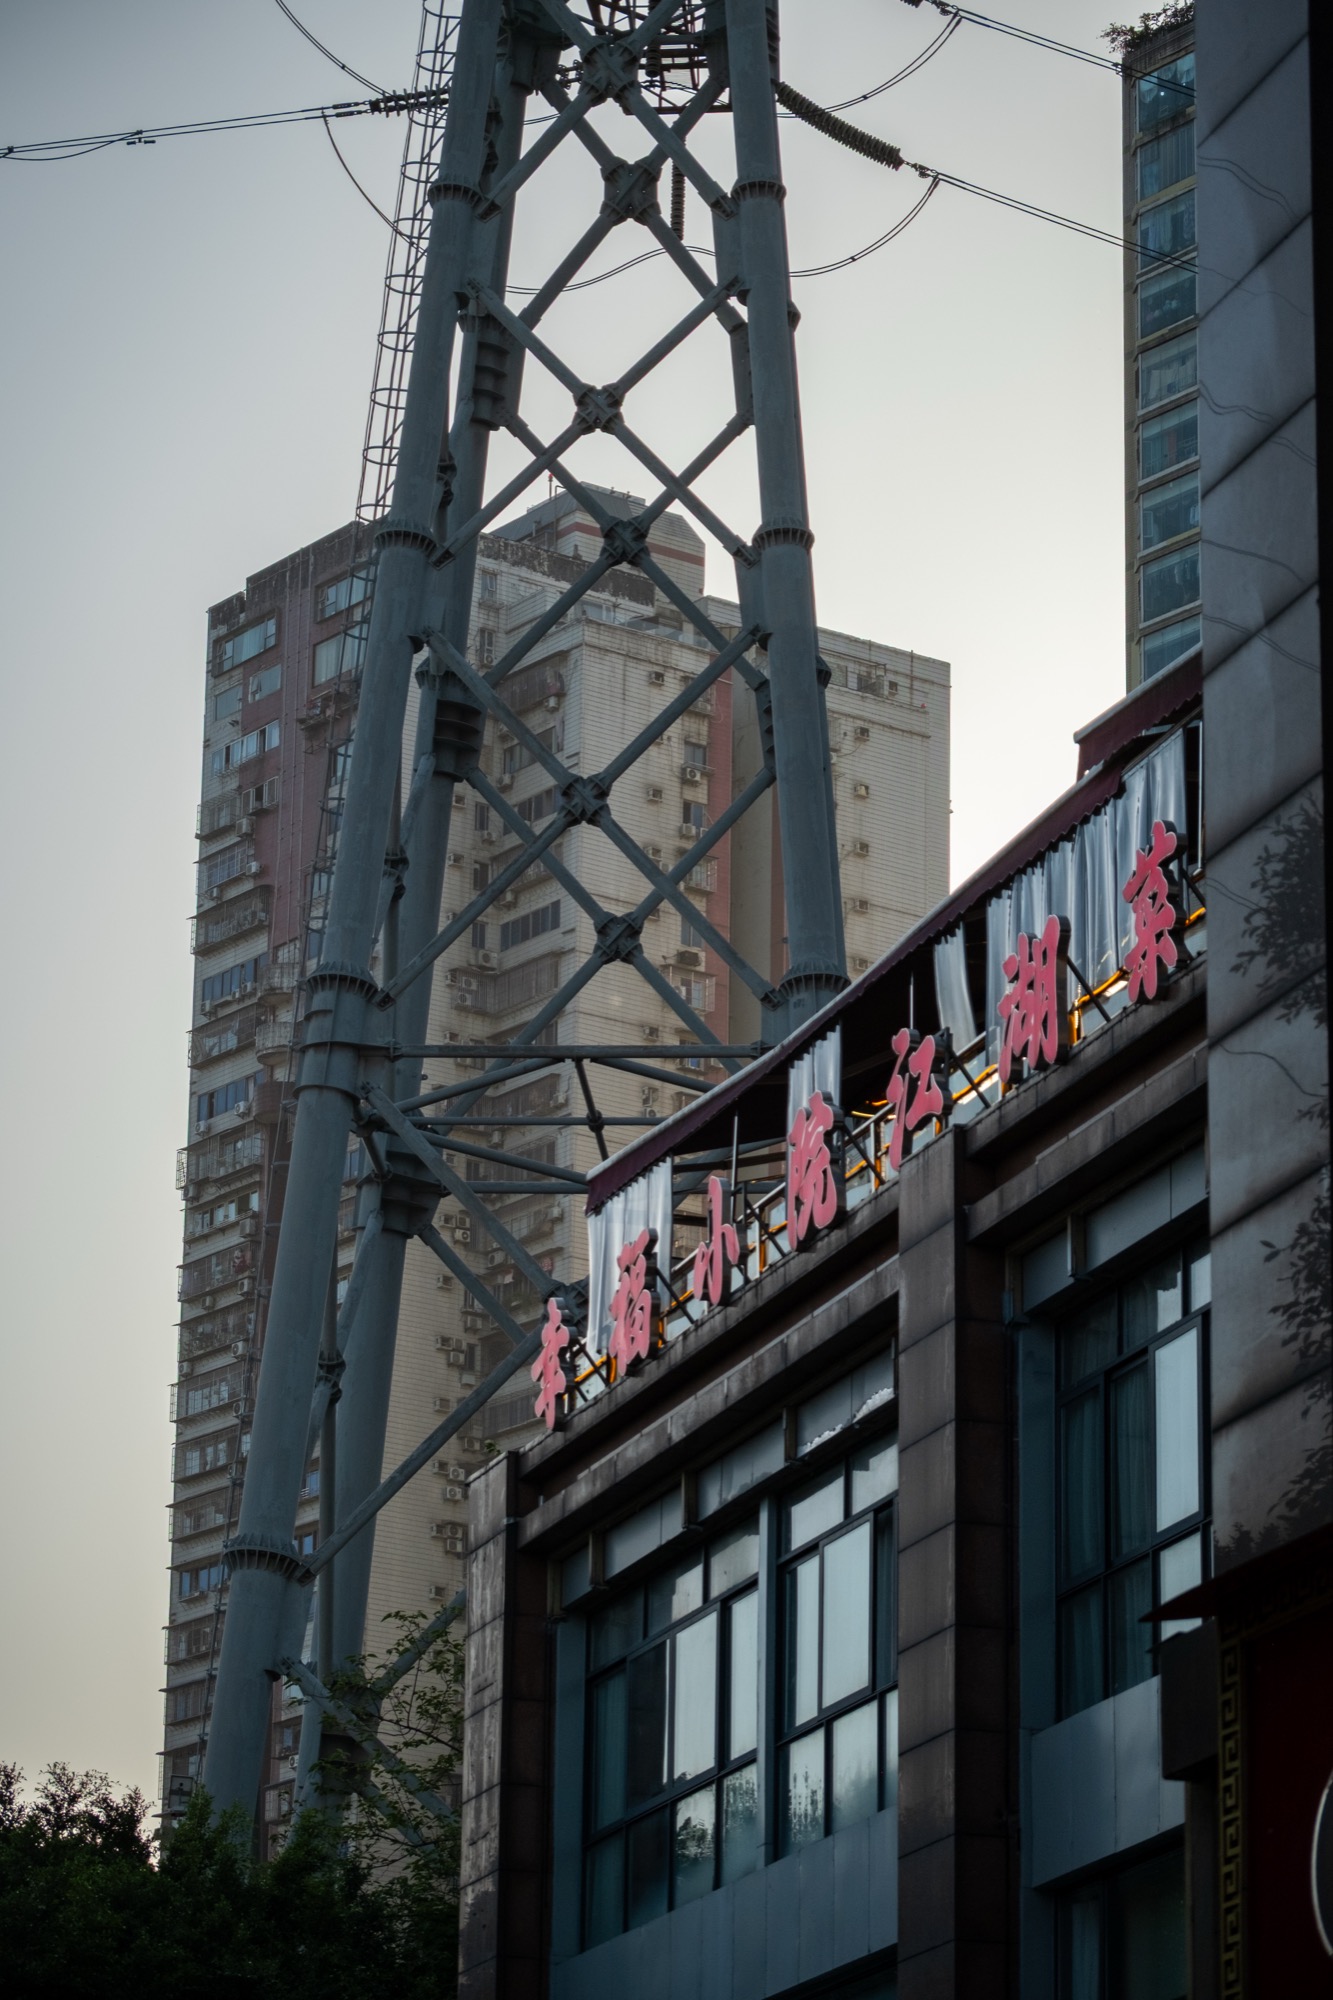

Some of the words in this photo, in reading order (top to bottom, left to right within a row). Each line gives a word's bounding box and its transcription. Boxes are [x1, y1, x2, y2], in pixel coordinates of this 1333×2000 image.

[531, 820, 1178, 1431] 幸福小院江湖菜
